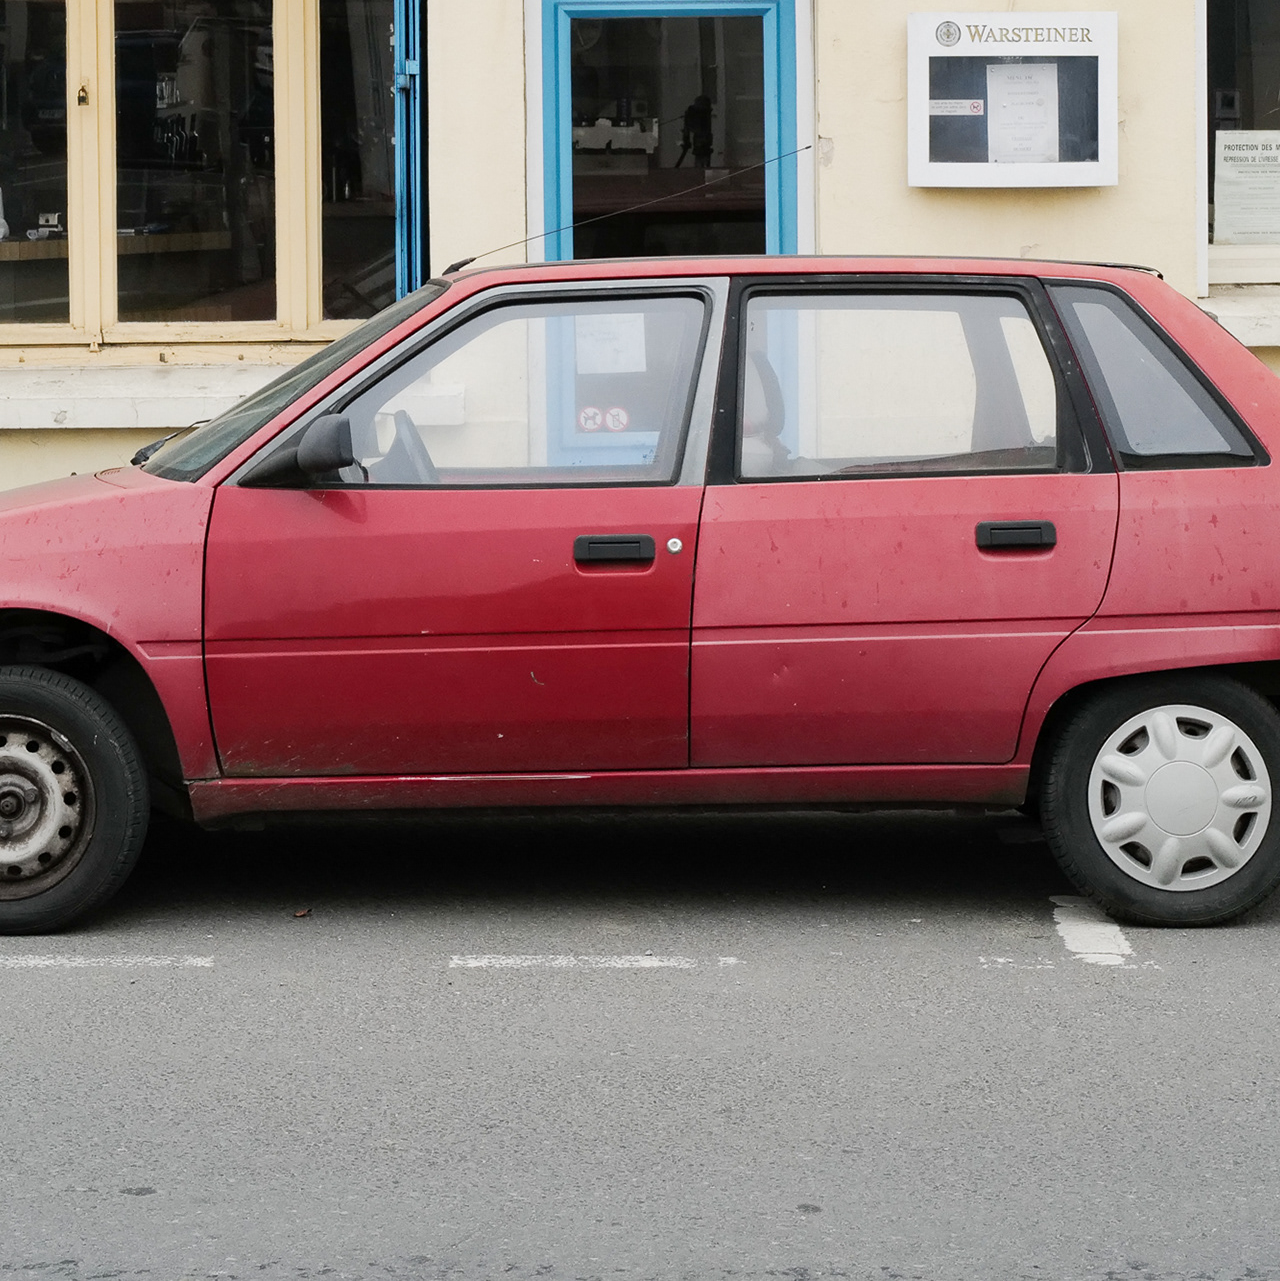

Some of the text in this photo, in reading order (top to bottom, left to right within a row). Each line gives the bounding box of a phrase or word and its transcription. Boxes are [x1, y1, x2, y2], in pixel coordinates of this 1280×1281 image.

[965, 23, 1093, 44] WARSTEINER
[1223, 143, 1259, 151] PROTECTION
[1261, 143, 1273, 151] DES
